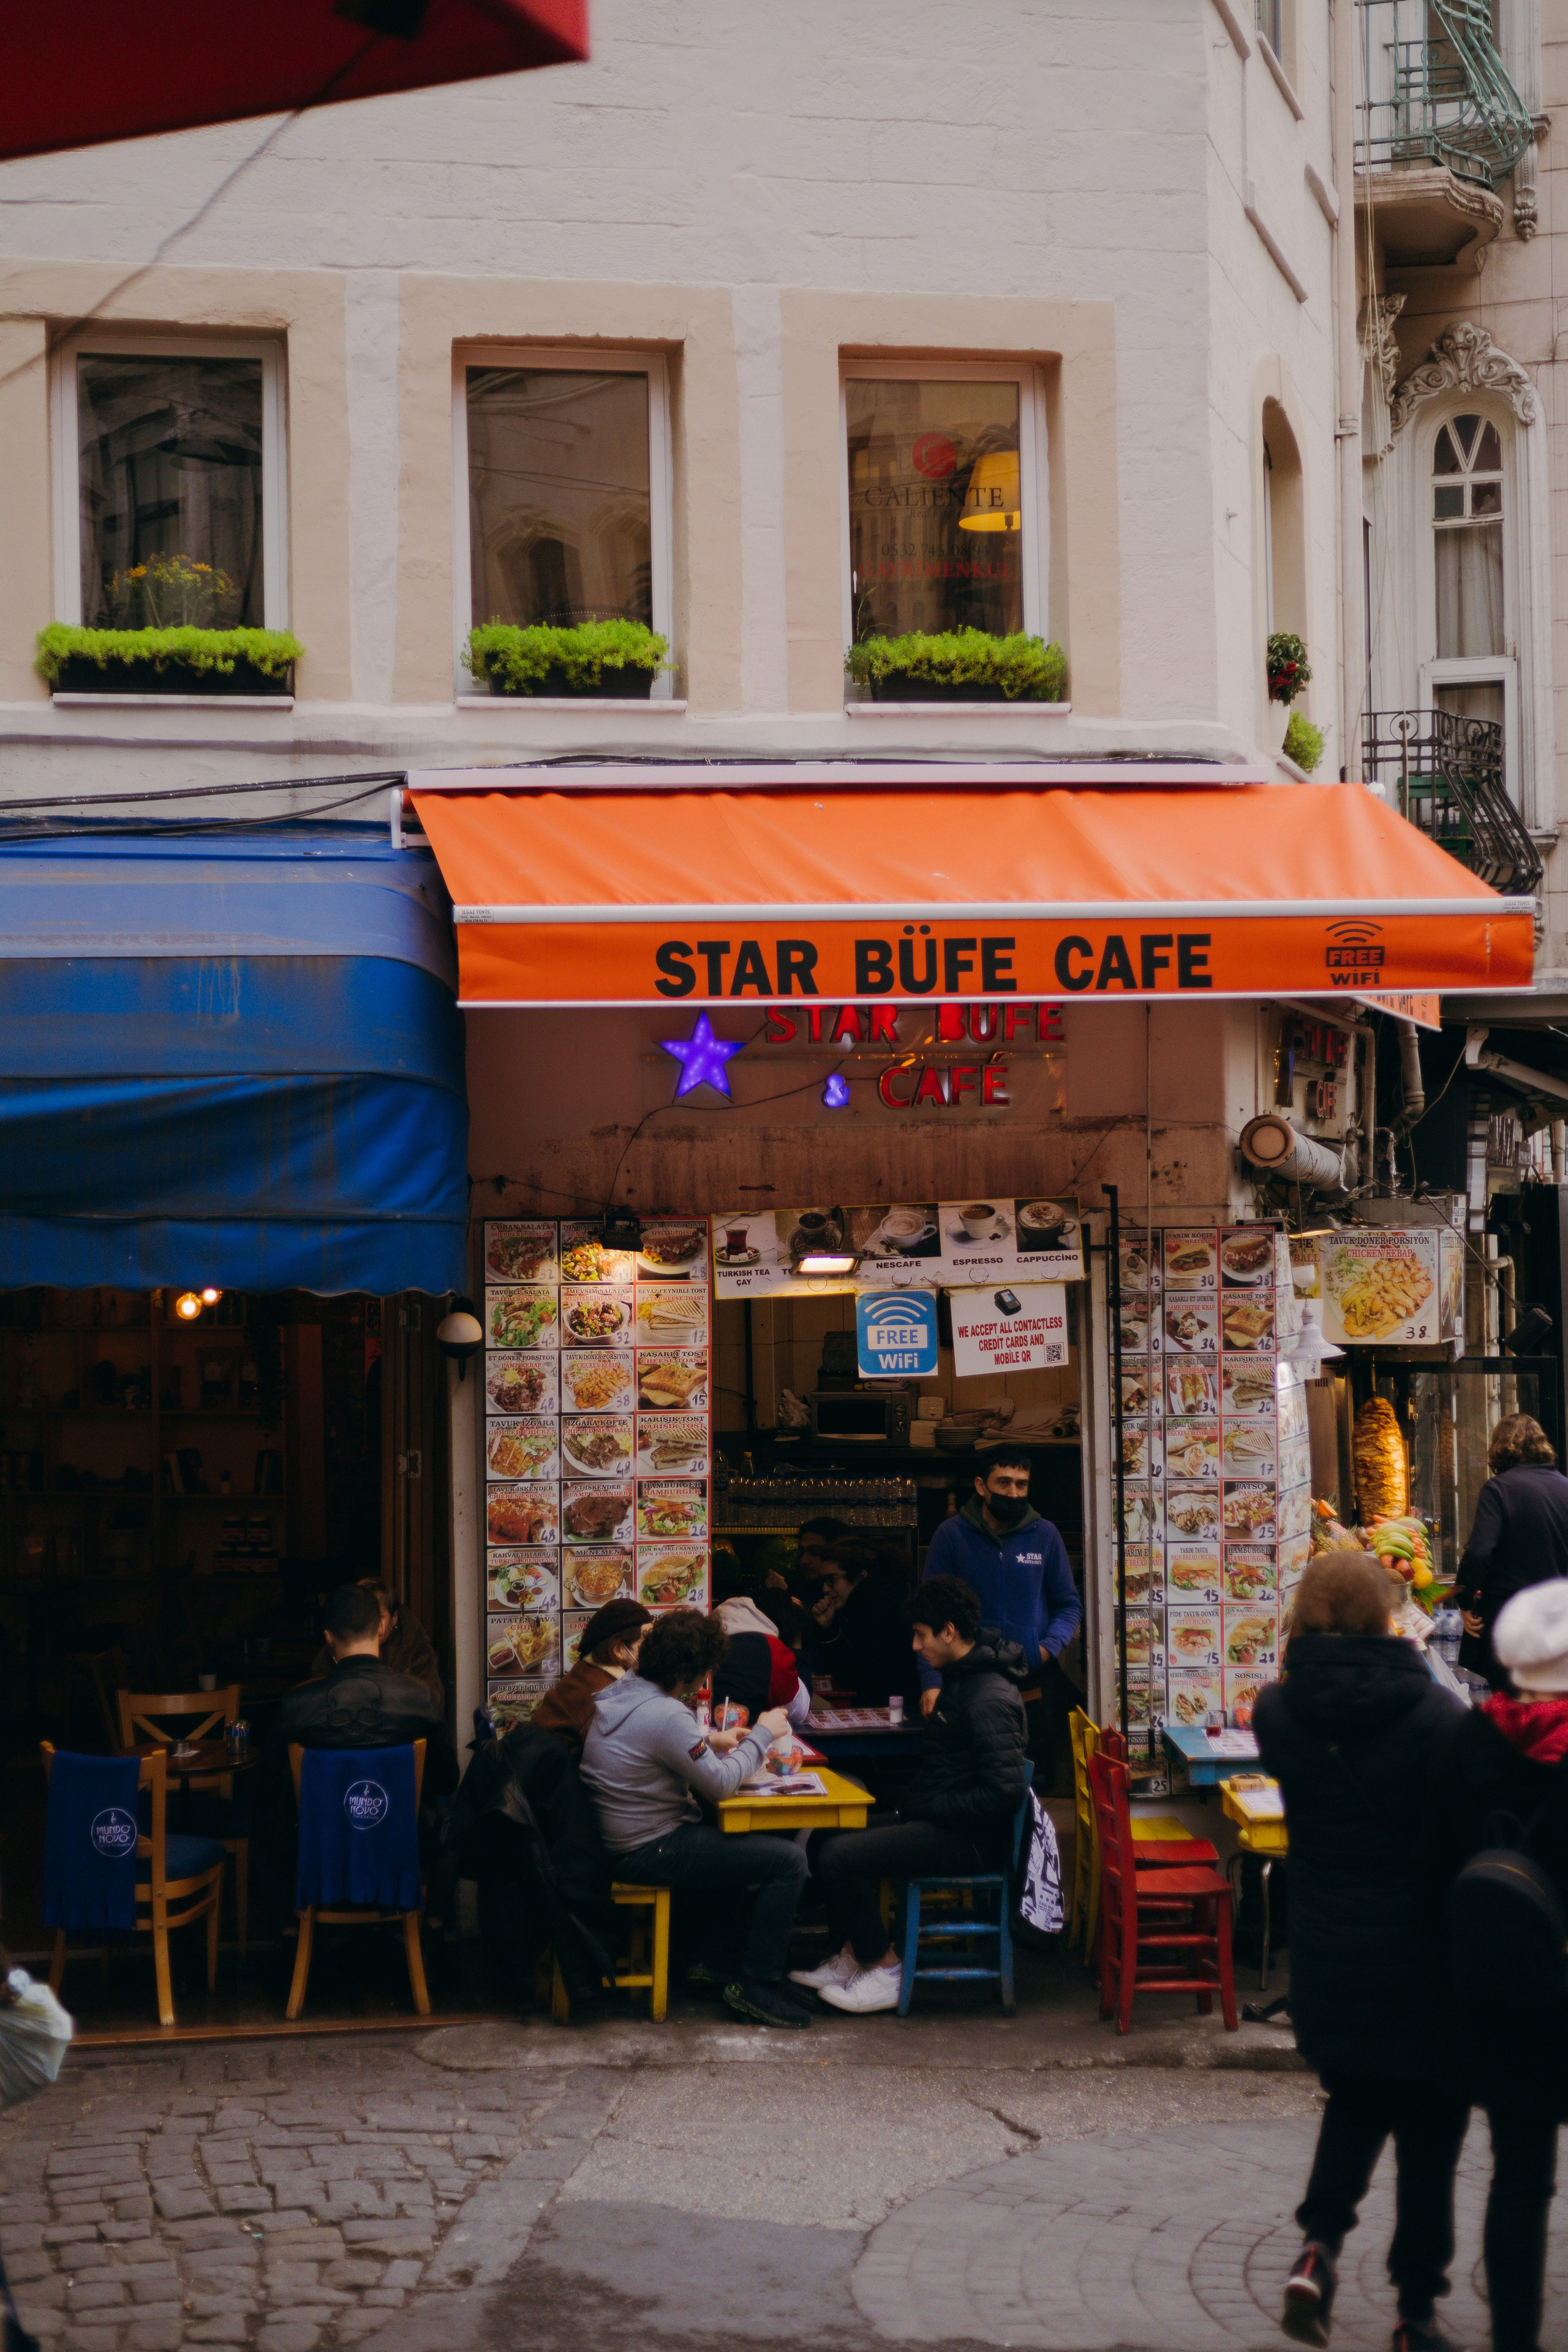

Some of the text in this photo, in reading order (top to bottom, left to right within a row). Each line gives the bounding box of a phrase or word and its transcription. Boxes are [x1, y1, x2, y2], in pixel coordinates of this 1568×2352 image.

[864, 488, 1004, 507] CALIENTE
[655, 924, 1212, 997] STAR BÜFE CAFE
[1328, 948, 1383, 966] FREE
[766, 1003, 900, 1042] STAR
[880, 1051, 1011, 1108] CAFÉ
[1329, 1236, 1355, 1245] TAVUK
[1357, 1234, 1387, 1245] DÖNER
[1388, 1234, 1430, 1245] PORSİYON
[1016, 1254, 1079, 1263] CAPPUCCİNO
[1346, 1248, 1414, 1257] CHICKEN KEBAP
[876, 1261, 921, 1269] NESCAFE
[952, 1257, 1003, 1266] ESPRESSO
[691, 1267, 705, 1279] 28
[1201, 1274, 1215, 1287] 30
[958, 1316, 1063, 1338] WE ACCEPT ALL CONTACTLESS
[1405, 1325, 1428, 1340] 38
[616, 1331, 630, 1344] 32
[876, 1329, 919, 1344] FREE
[979, 1333, 1044, 1351] CREDİT CARDS AND
[1200, 1338, 1216, 1351] 34
[1258, 1338, 1272, 1351] 16
[878, 1352, 918, 1369] WiFi
[994, 1349, 1031, 1365] MOBİLE QR
[540, 1396, 554, 1413] 48
[617, 1395, 630, 1408] 38
[692, 1393, 707, 1406] 15
[616, 1461, 631, 1477] 48
[690, 1460, 704, 1472] 20
[1202, 1463, 1218, 1477] 24
[1260, 1463, 1274, 1476] 17
[541, 1528, 556, 1543] 48
[614, 1525, 632, 1540] 58
[690, 1525, 707, 1537] 26
[1202, 1526, 1218, 1540] 24
[1259, 1526, 1275, 1539] 25
[688, 1589, 704, 1602] 28
[1204, 1589, 1219, 1602] 15
[1258, 1589, 1275, 1601] 26
[542, 1594, 557, 1611] 48
[1204, 1651, 1219, 1665] 15
[1259, 1652, 1275, 1664] 28
[1153, 1779, 1167, 1792] 25
[350, 1796, 383, 1807] MUNDO
[350, 1806, 379, 1815] NOVO
[97, 1825, 131, 1834] MUNDO
[99, 1834, 130, 1844] NOVO
